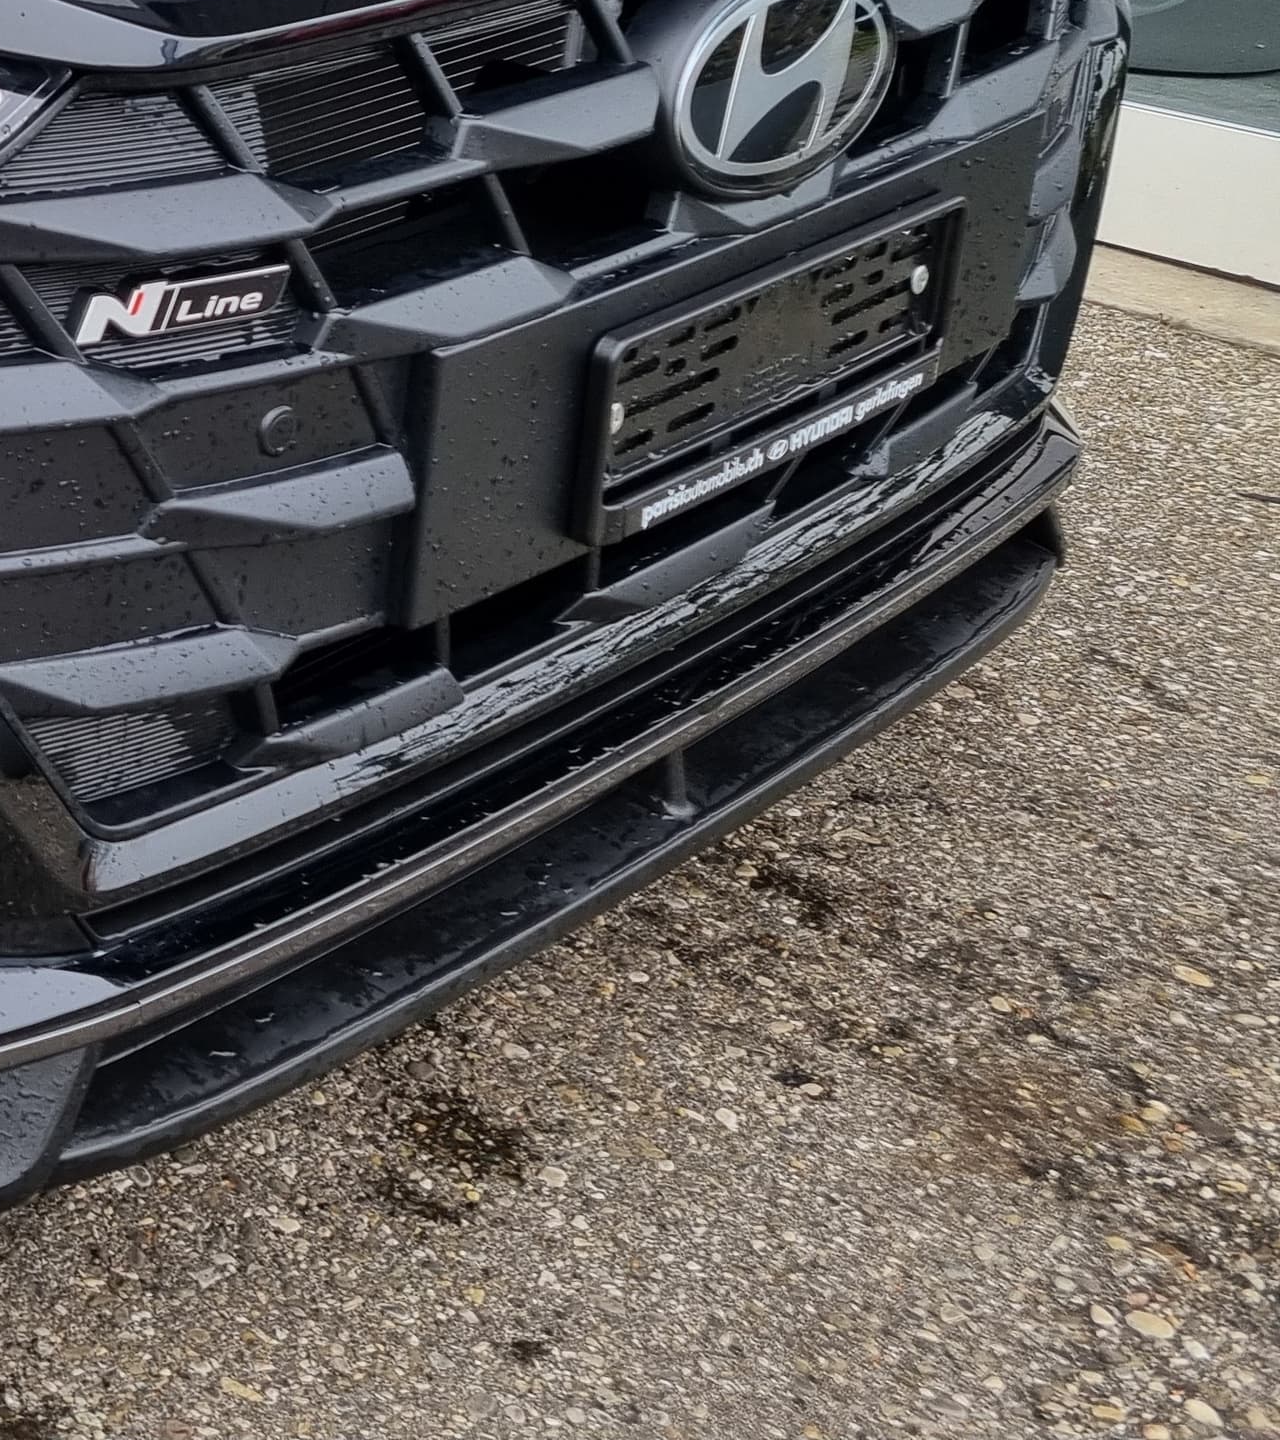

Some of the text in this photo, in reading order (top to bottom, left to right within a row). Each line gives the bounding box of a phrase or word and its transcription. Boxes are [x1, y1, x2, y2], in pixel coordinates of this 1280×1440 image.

[75, 280, 265, 346] N Line
[789, 404, 854, 452] HYUNDAI
